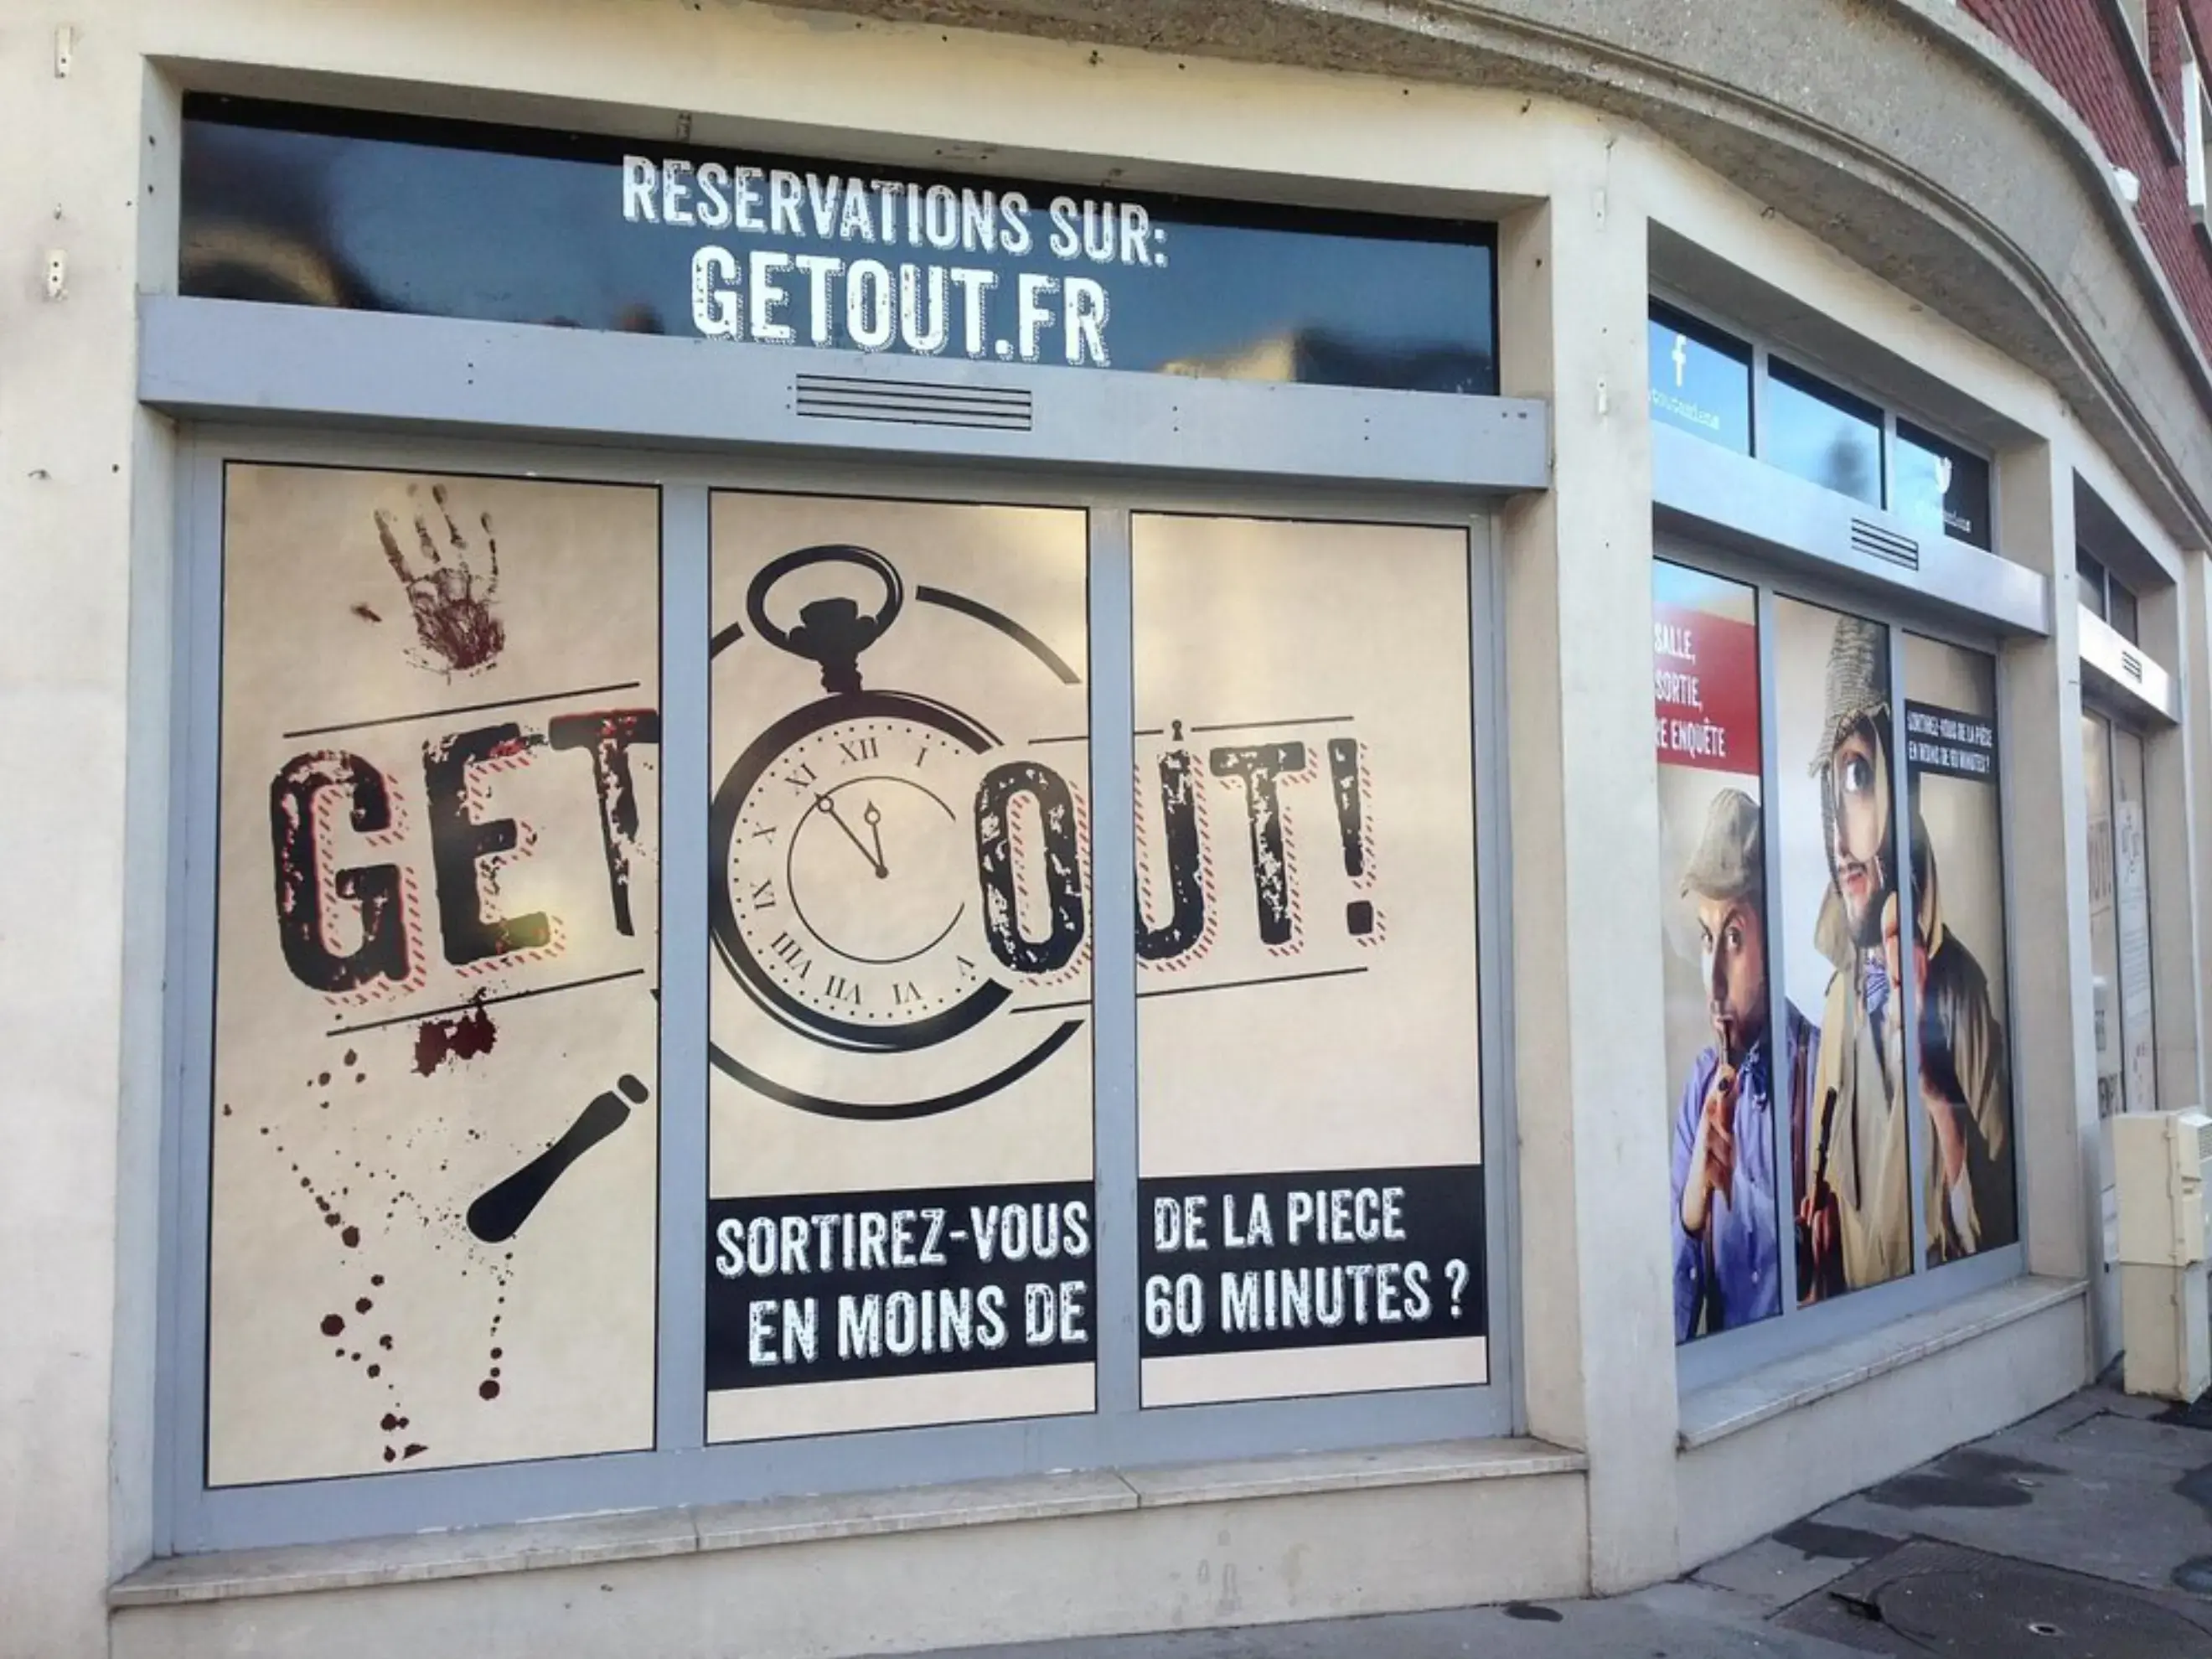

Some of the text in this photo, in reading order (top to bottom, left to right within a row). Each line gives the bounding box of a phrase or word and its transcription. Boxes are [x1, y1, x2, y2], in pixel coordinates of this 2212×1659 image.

[622, 154, 1169, 268] RESERVATIONS SUR:
[690, 245, 1112, 368] GETOUT.FR
[270, 708, 1382, 997] GET OUT!
[715, 1186, 1407, 1279] SORTIREZ-VOUS DE LA PIECE
[747, 1296, 821, 1367] EN
[838, 1284, 1008, 1358] MOINS
[1024, 1280, 1089, 1345] DE
[1144, 1274, 1205, 1336] 60
[1220, 1261, 1432, 1331] MINUTES
